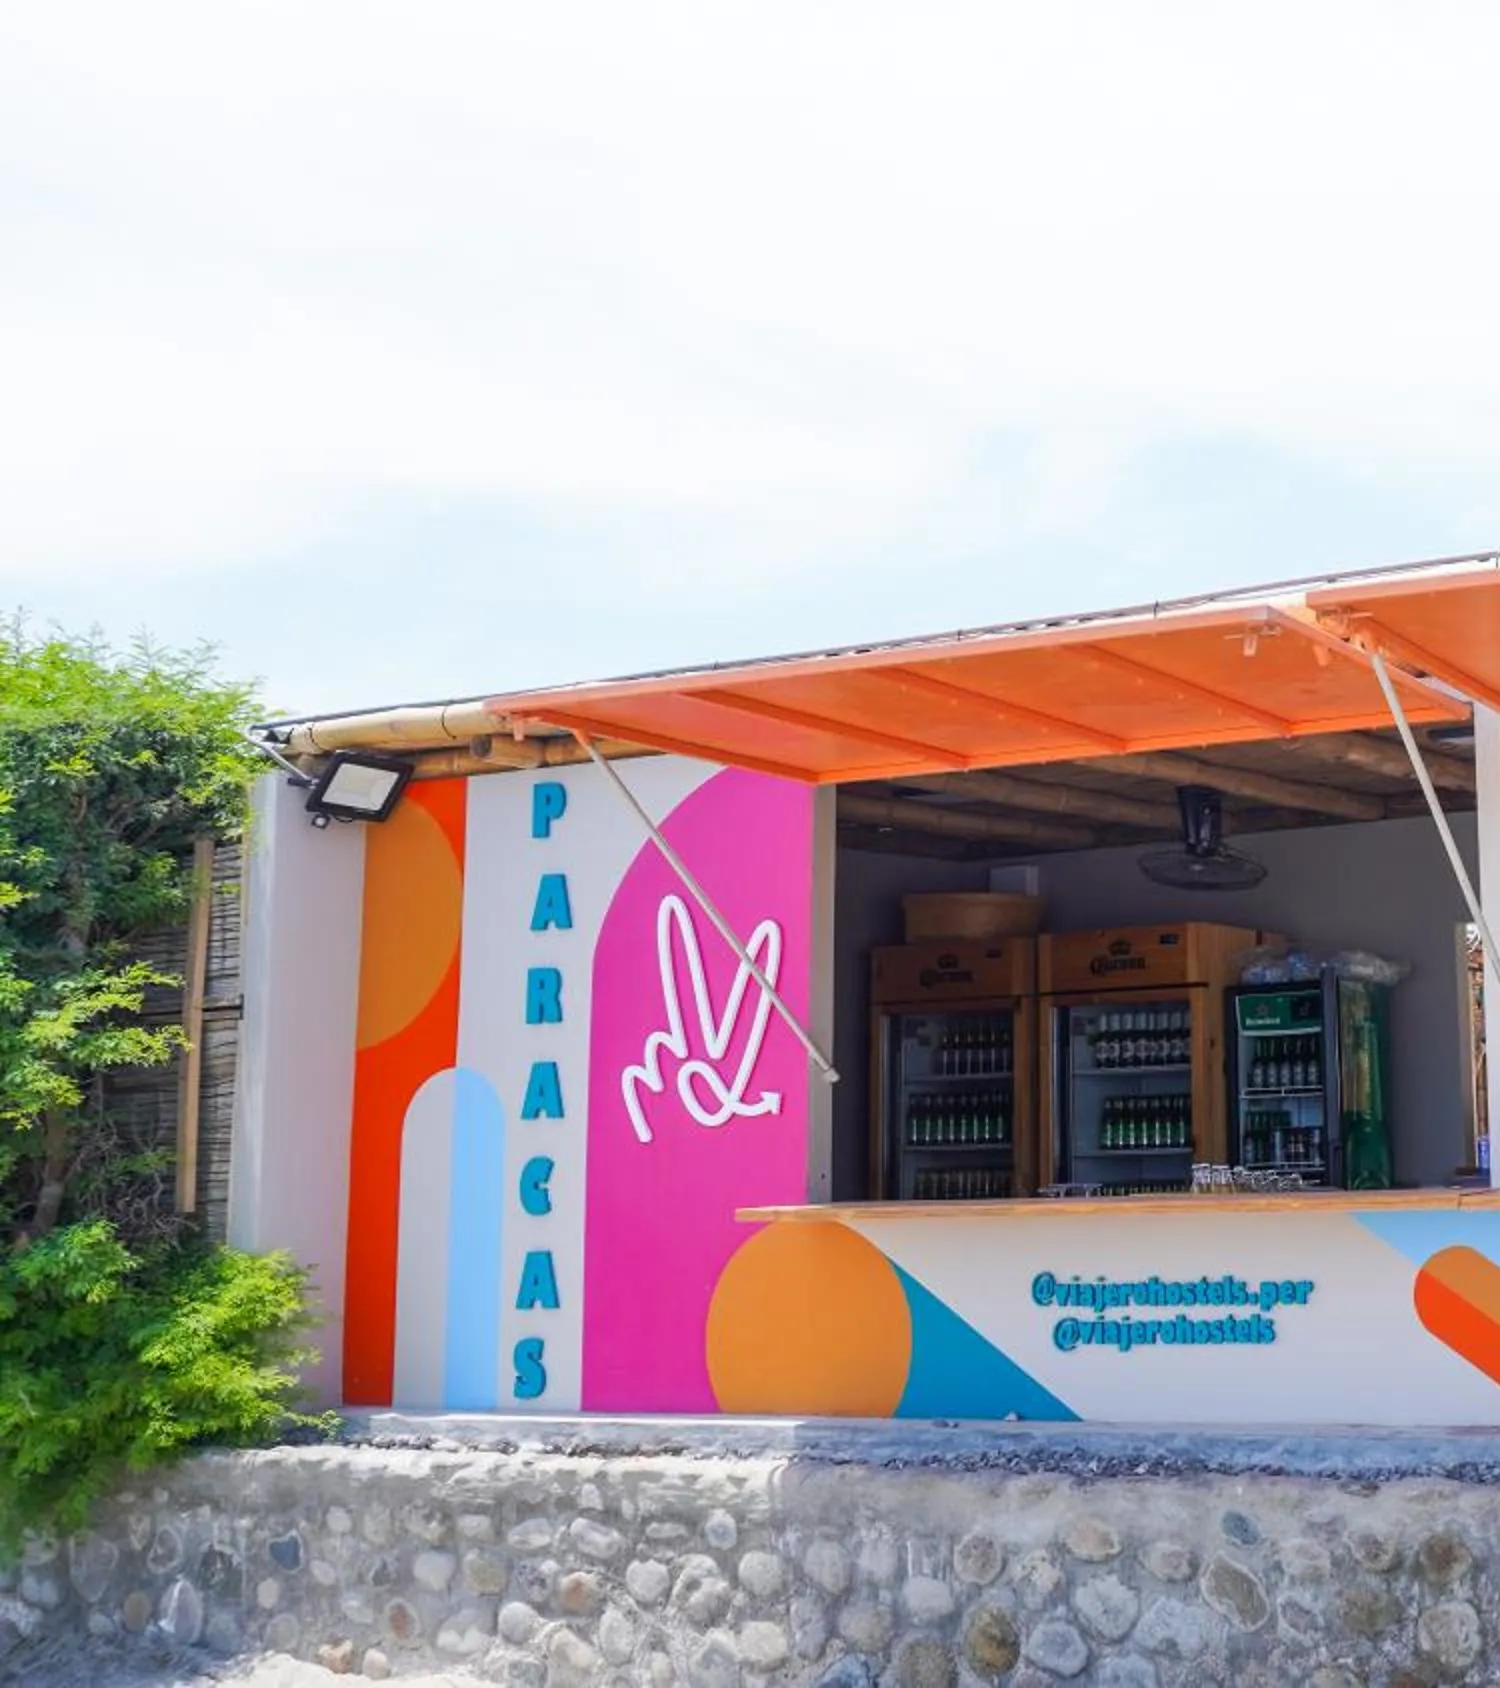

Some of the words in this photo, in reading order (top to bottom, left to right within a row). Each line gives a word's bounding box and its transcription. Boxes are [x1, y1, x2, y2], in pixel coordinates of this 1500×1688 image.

[513, 782, 572, 1400] PARACAS
[1031, 1271, 1315, 1312] @viajerohostels.per
[1052, 1313, 1277, 1352] @viajerohostels
